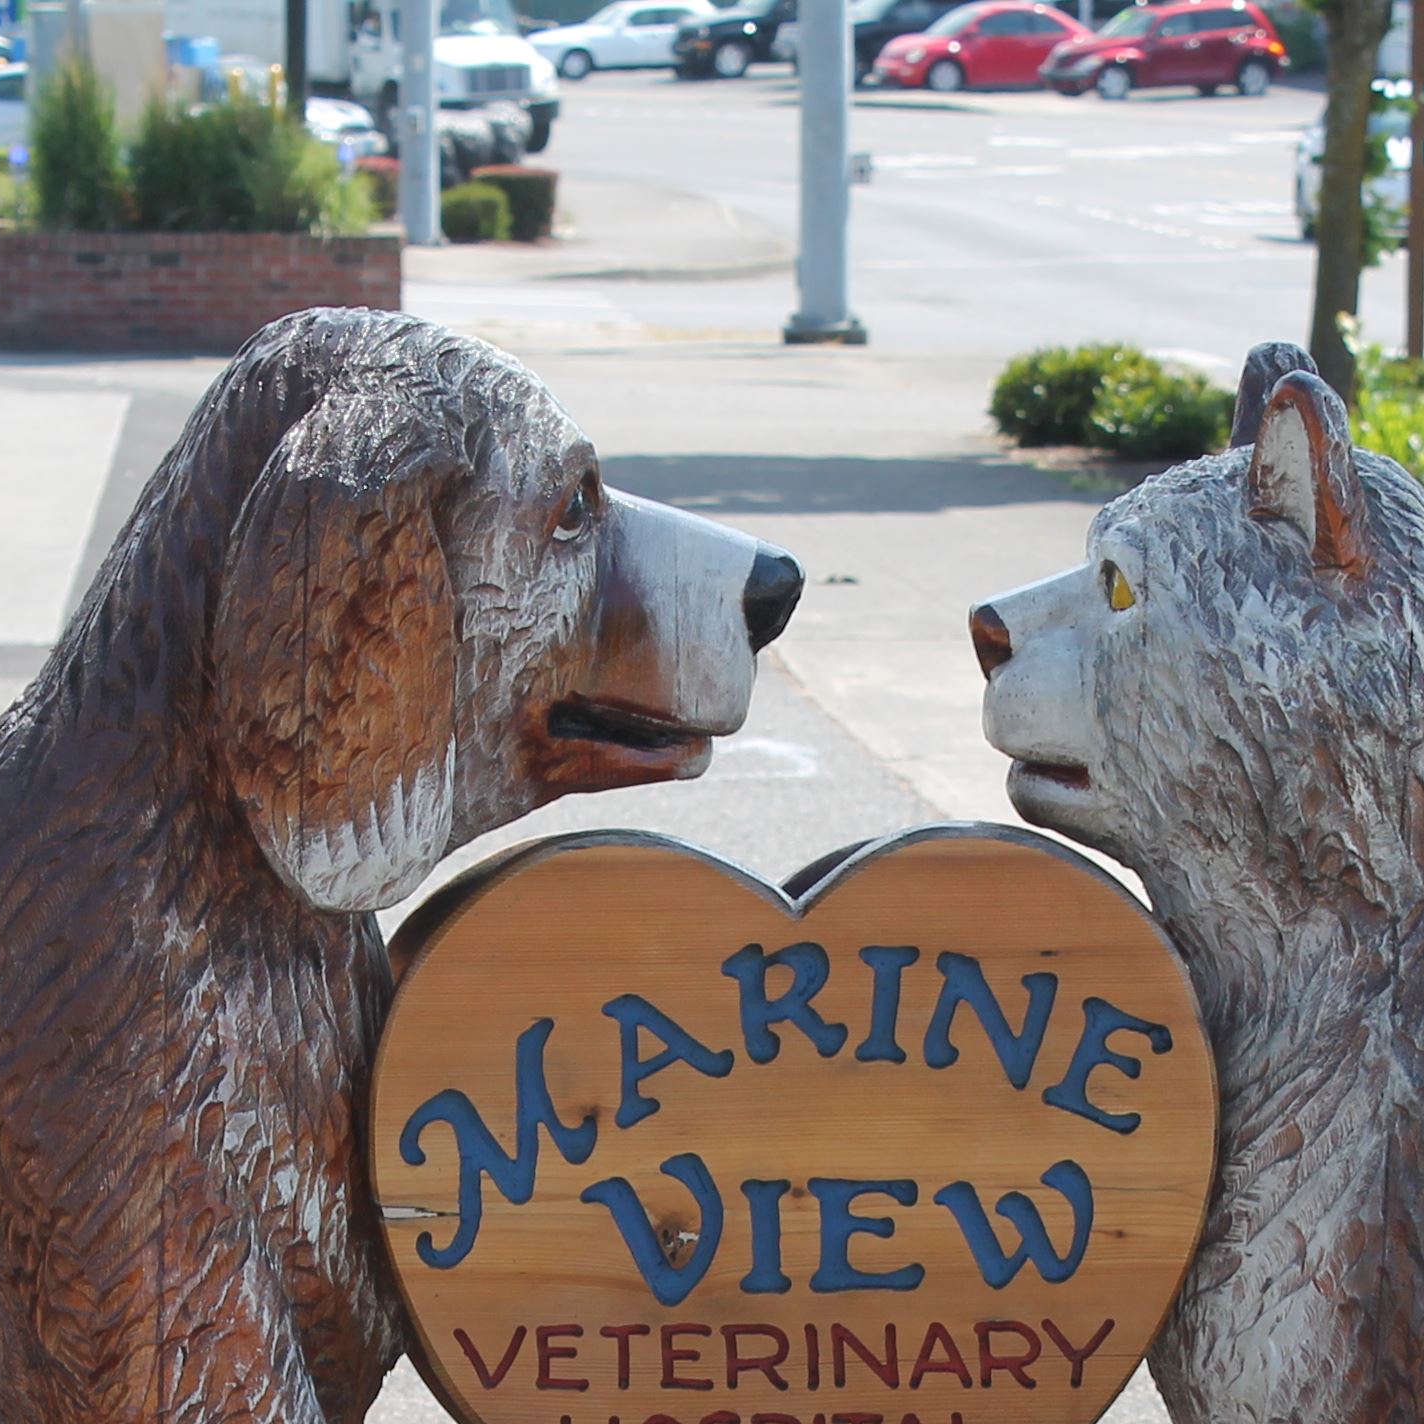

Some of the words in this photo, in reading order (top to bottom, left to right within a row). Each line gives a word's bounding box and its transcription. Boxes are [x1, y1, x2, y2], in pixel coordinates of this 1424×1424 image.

[399, 942, 1172, 1268] MARINE
[581, 1153, 1094, 1306] VIEW
[454, 1318, 1115, 1391] VETERINARY
